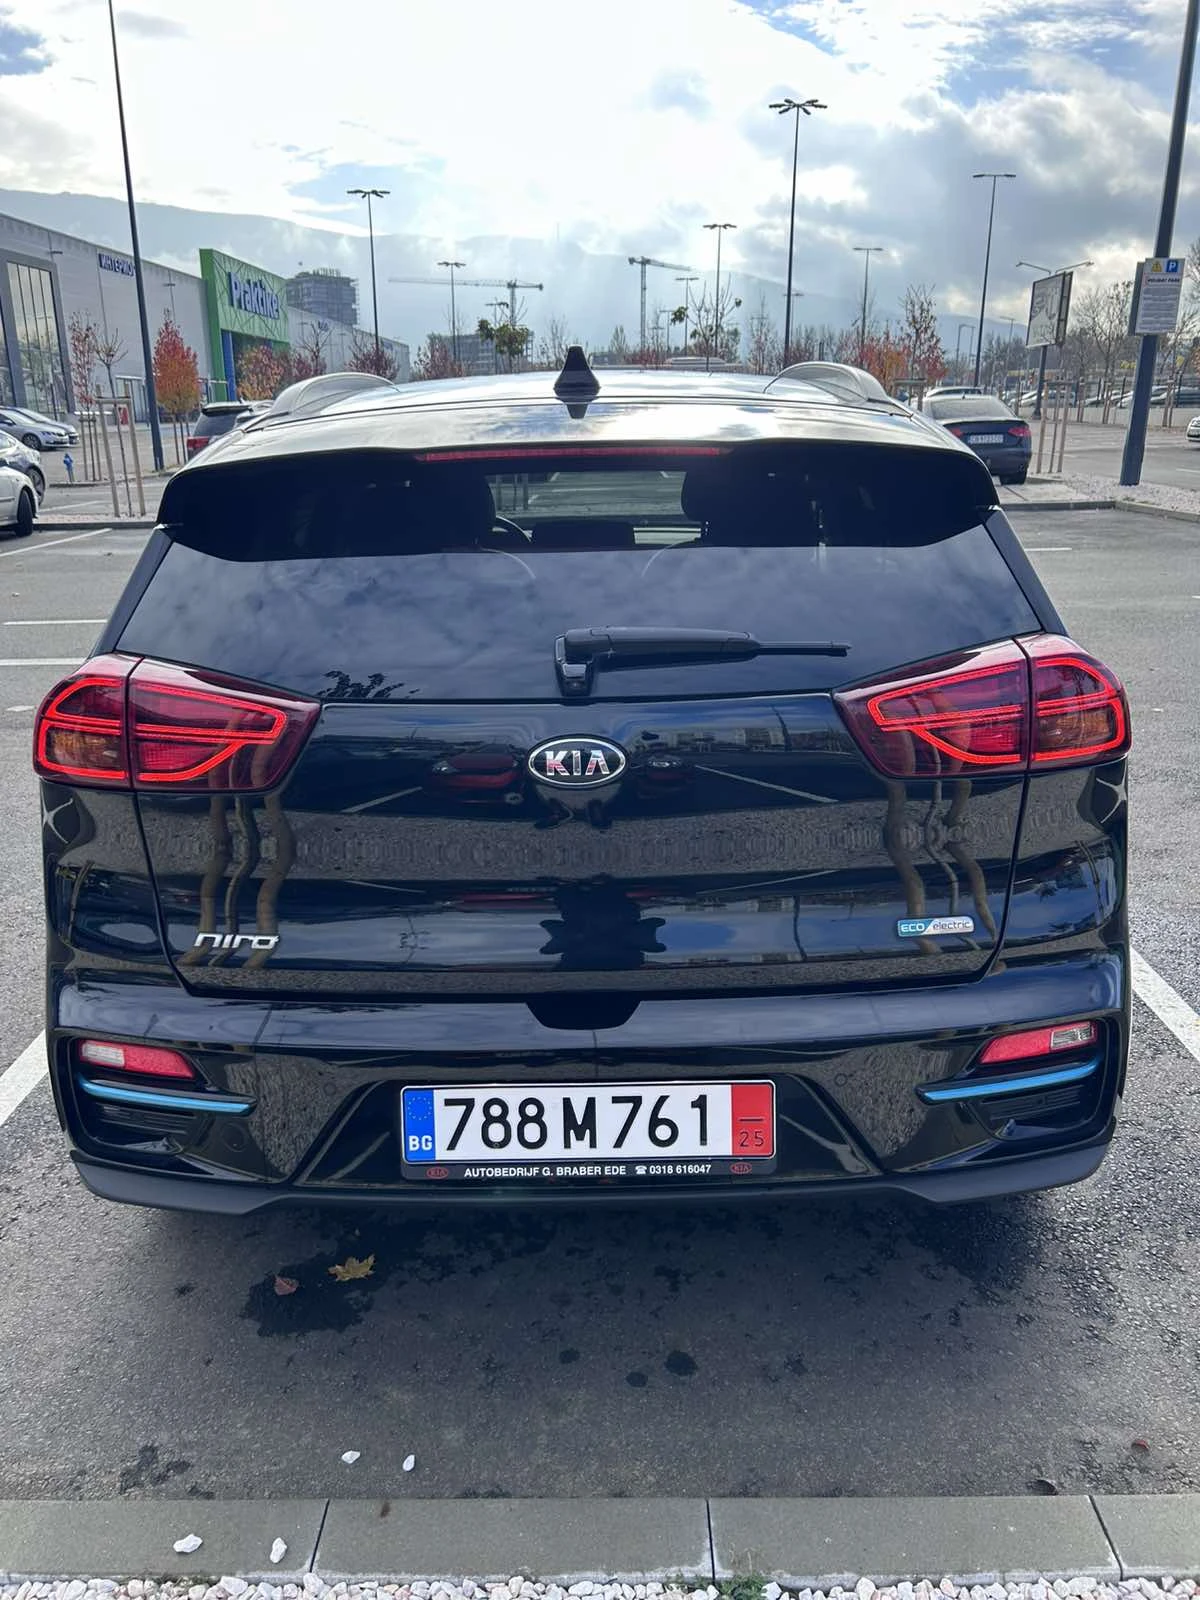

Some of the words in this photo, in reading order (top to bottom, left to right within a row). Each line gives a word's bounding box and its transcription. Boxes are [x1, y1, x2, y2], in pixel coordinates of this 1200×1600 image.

[544, 749, 611, 777] KIA
[900, 922, 926, 933] ECO
[932, 920, 971, 931] electric
[193, 932, 280, 950] niro
[443, 1097, 548, 1151] 788
[562, 1096, 598, 1150] M
[611, 1094, 708, 1149] 761
[408, 1134, 433, 1152] BG
[739, 1130, 765, 1148] 25
[464, 1167, 539, 1178] AUTOBEDRIJF
[542, 1166, 553, 1177] G.
[556, 1165, 602, 1176] BRABER
[604, 1165, 627, 1176] EDE
[649, 1164, 674, 1175] 0318
[675, 1163, 712, 1175] 616047
